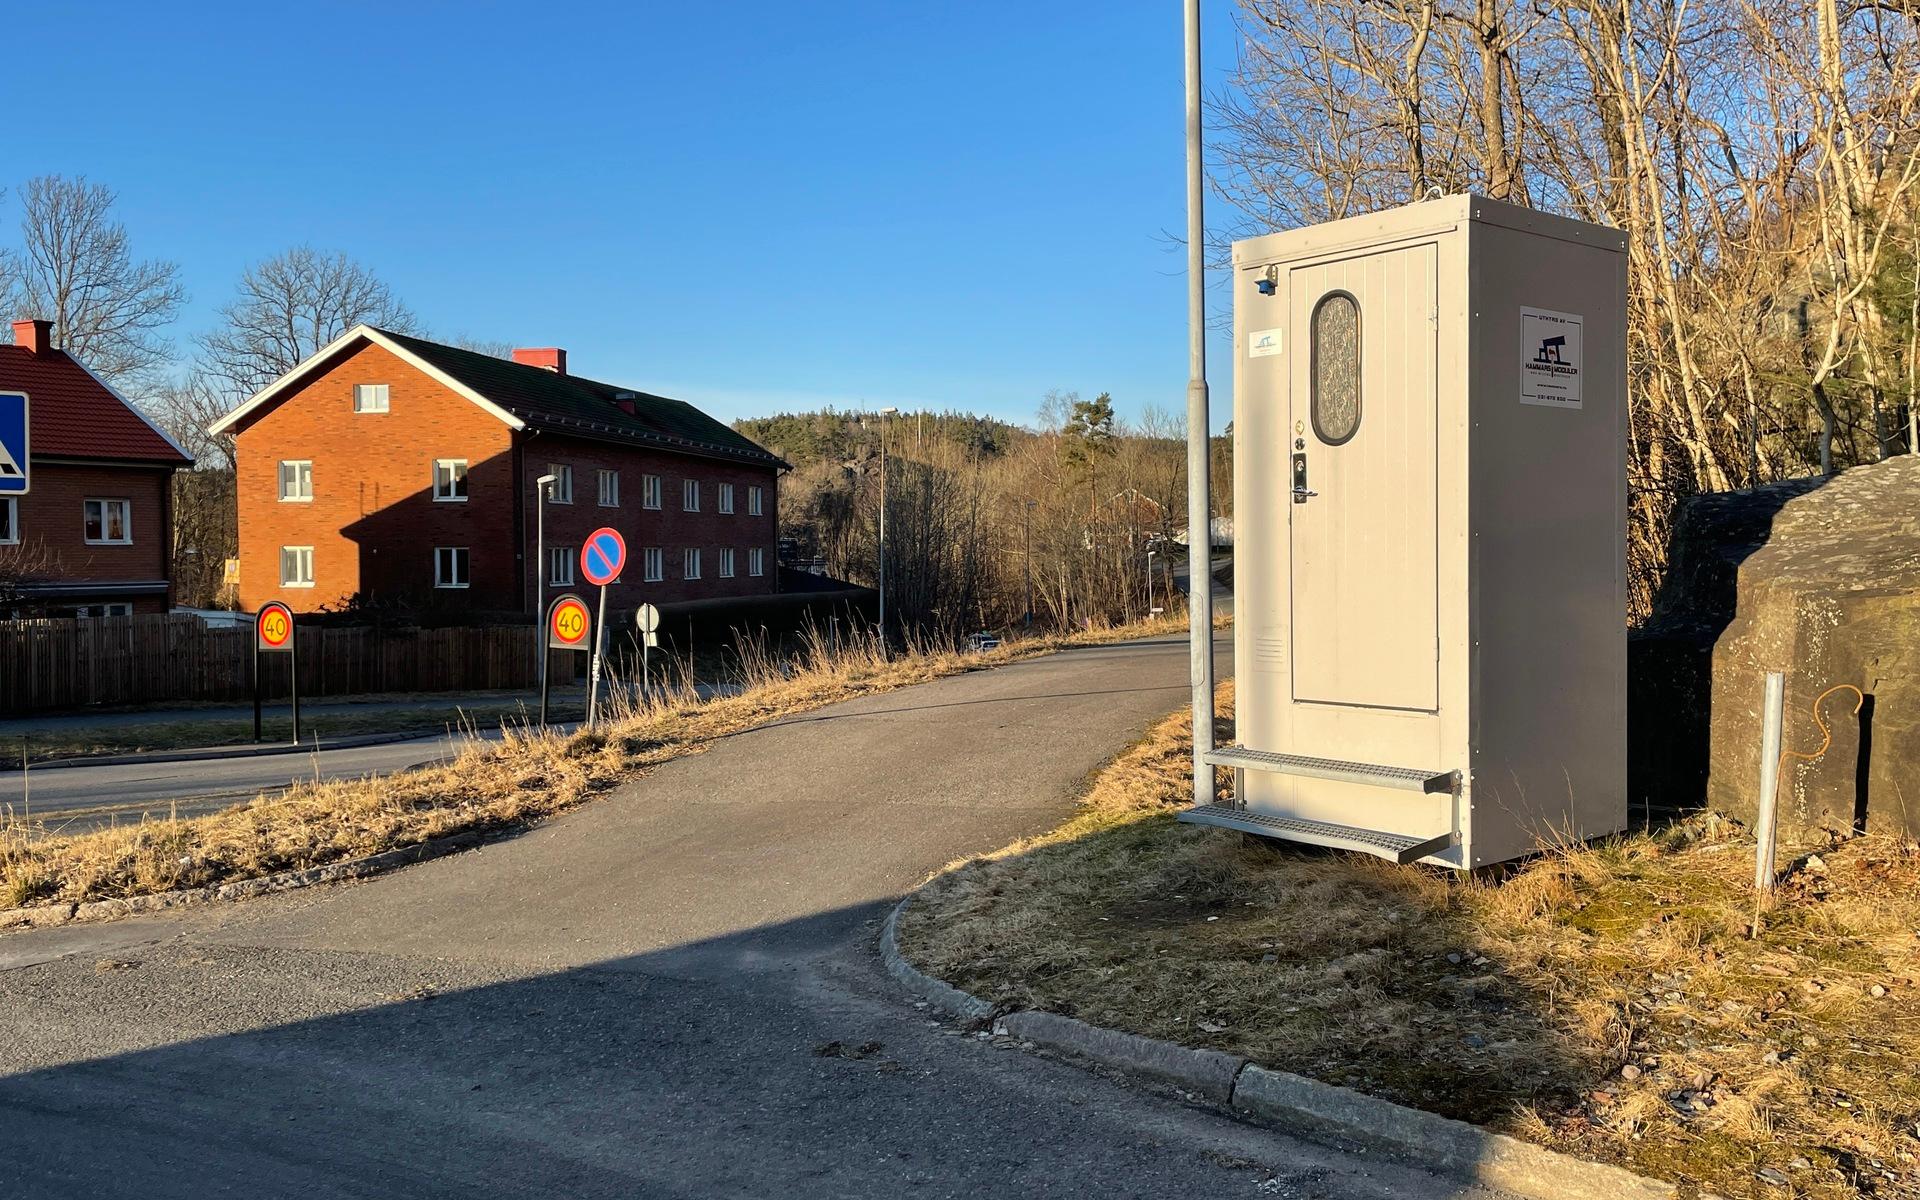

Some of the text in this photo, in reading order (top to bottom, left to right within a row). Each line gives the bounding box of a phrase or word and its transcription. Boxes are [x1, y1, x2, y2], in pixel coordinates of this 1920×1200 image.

[1525, 362, 1551, 372] HAMMARS
[1553, 366, 1577, 375] MODULER
[266, 618, 286, 636] 40
[558, 613, 582, 633] 40
